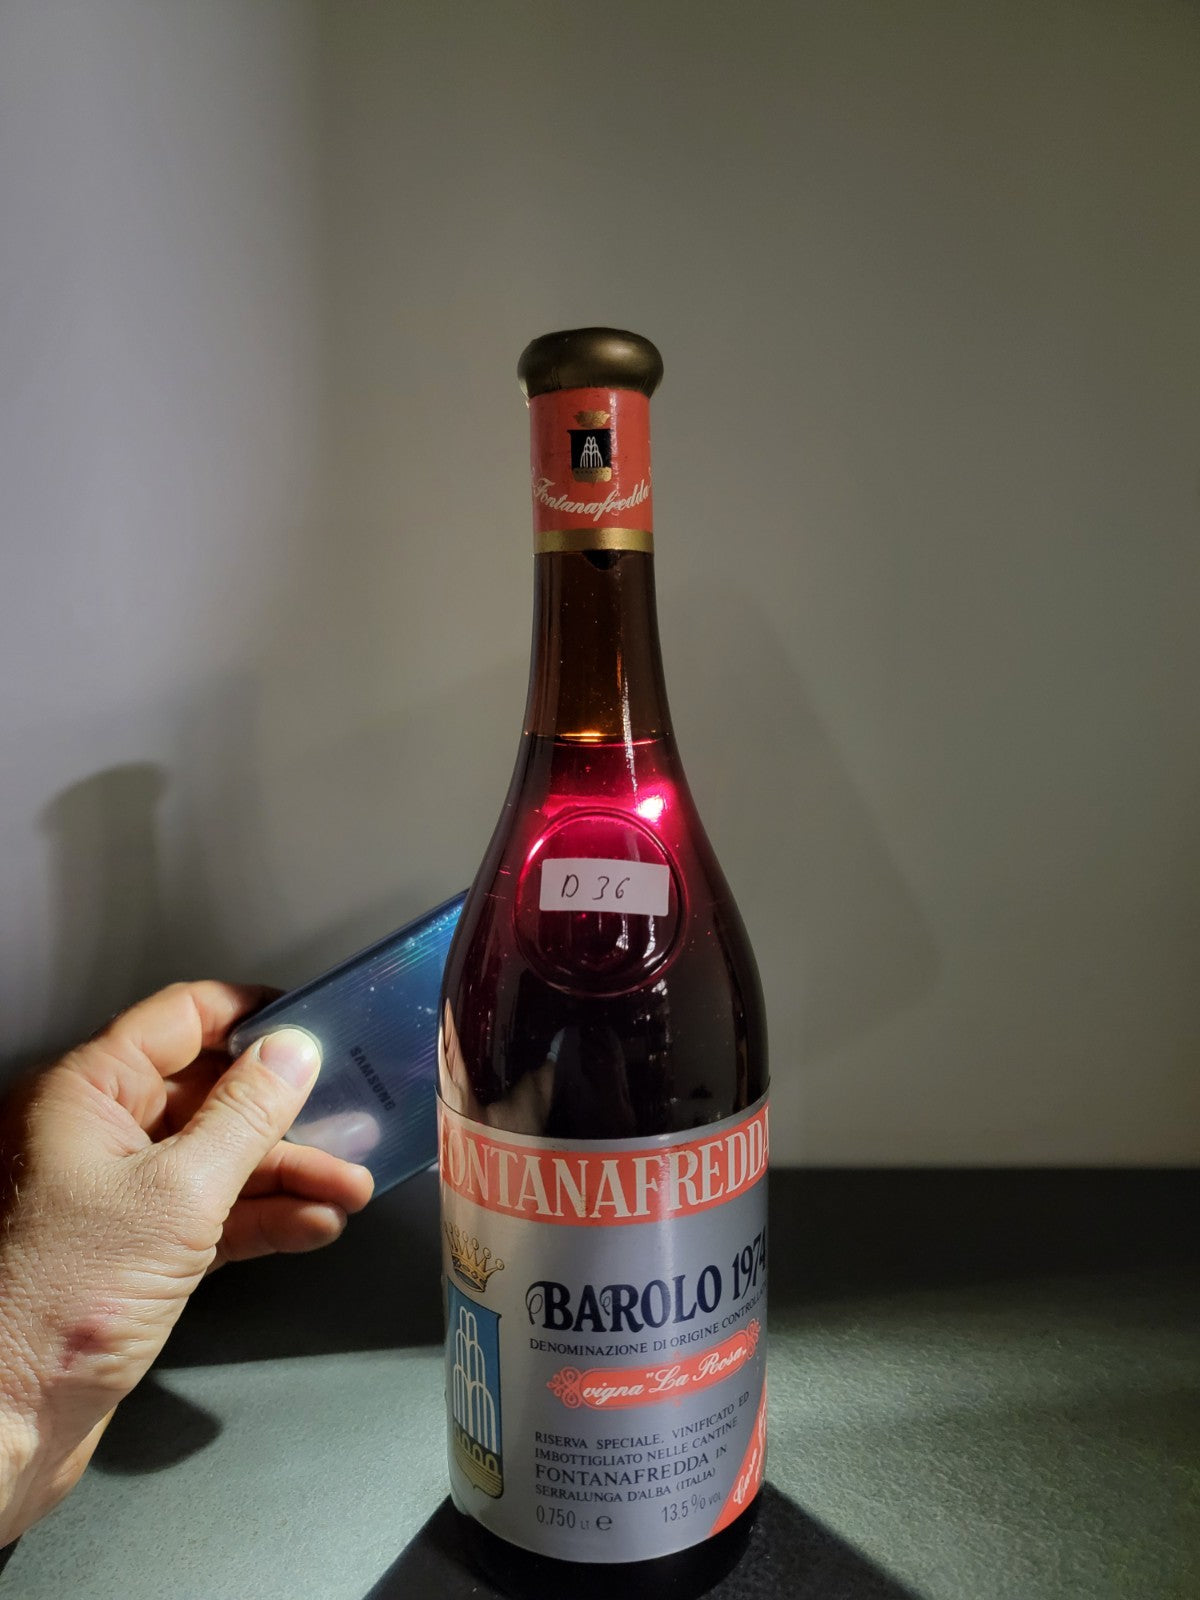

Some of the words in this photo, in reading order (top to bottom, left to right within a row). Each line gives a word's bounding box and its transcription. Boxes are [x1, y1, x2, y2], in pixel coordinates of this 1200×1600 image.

[533, 477, 651, 522] Fontanafredda
[561, 873, 580, 898] D
[592, 876, 631, 901] 36
[350, 1046, 396, 1111] SAMSUNG
[525, 1264, 722, 1333] BAROLO
[732, 1226, 766, 1301] 1974
[529, 1337, 648, 1356] DENOMINAZIONE
[653, 1339, 667, 1352] DI
[670, 1321, 719, 1350] ORIGINE
[582, 1382, 645, 1405] vigna
[535, 1431, 588, 1449] RISERVA
[672, 1403, 735, 1439] VINIFICATO
[738, 1391, 749, 1407] ED
[535, 1448, 643, 1466] IMBOTTIGLIATO
[648, 1442, 688, 1462] NELLE
[692, 1416, 738, 1449] CANTINE
[535, 1452, 709, 1486] FONTANAFREDDA
[715, 1444, 728, 1459] IN
[535, 1484, 622, 1503] SERRALUNGA
[627, 1485, 671, 1502] D'ALBA
[676, 1467, 716, 1492] (ITALIA)
